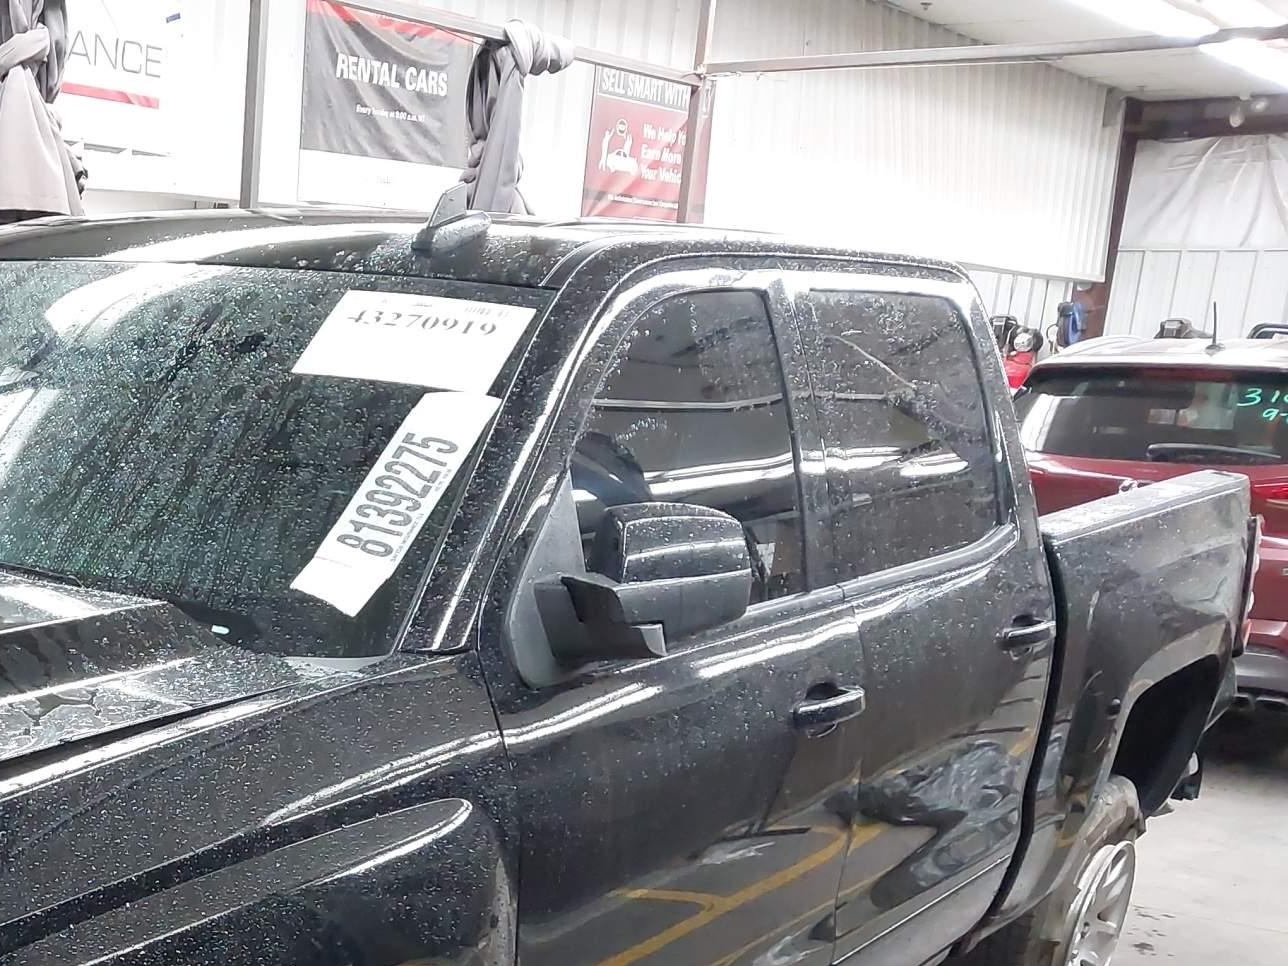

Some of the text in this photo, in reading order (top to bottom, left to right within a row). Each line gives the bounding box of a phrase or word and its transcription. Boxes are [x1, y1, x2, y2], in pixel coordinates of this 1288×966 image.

[65, 30, 162, 78] ANCE
[335, 53, 449, 97] RENTAL CARS
[601, 67, 691, 109] SELL SMART WITH
[643, 123, 657, 140] We
[678, 130, 687, 146] Yo
[659, 166, 682, 183] Vehic
[347, 308, 498, 336] 43270919
[336, 432, 459, 558] 81392275
